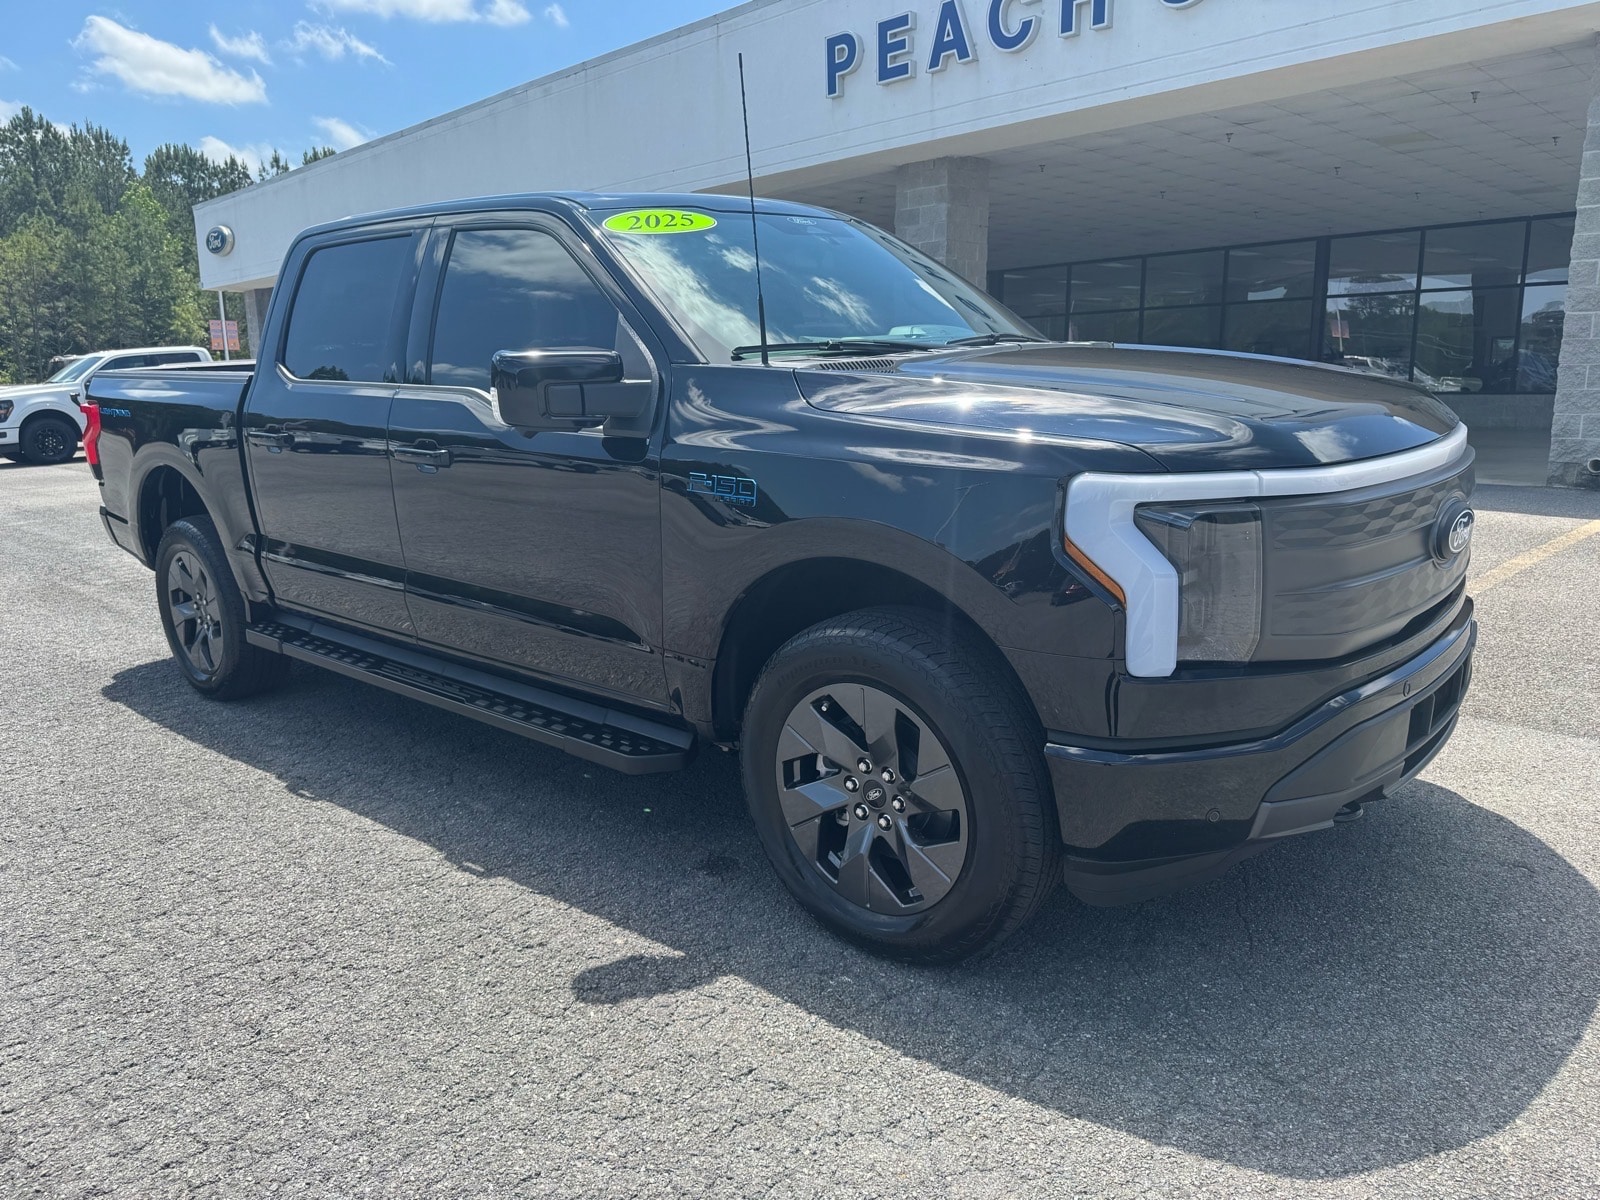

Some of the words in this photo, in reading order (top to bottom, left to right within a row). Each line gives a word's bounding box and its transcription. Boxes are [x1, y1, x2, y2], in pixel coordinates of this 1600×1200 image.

[627, 213, 694, 230] 2025
[207, 232, 222, 249] Ford
[1453, 515, 1473, 547] Ford
